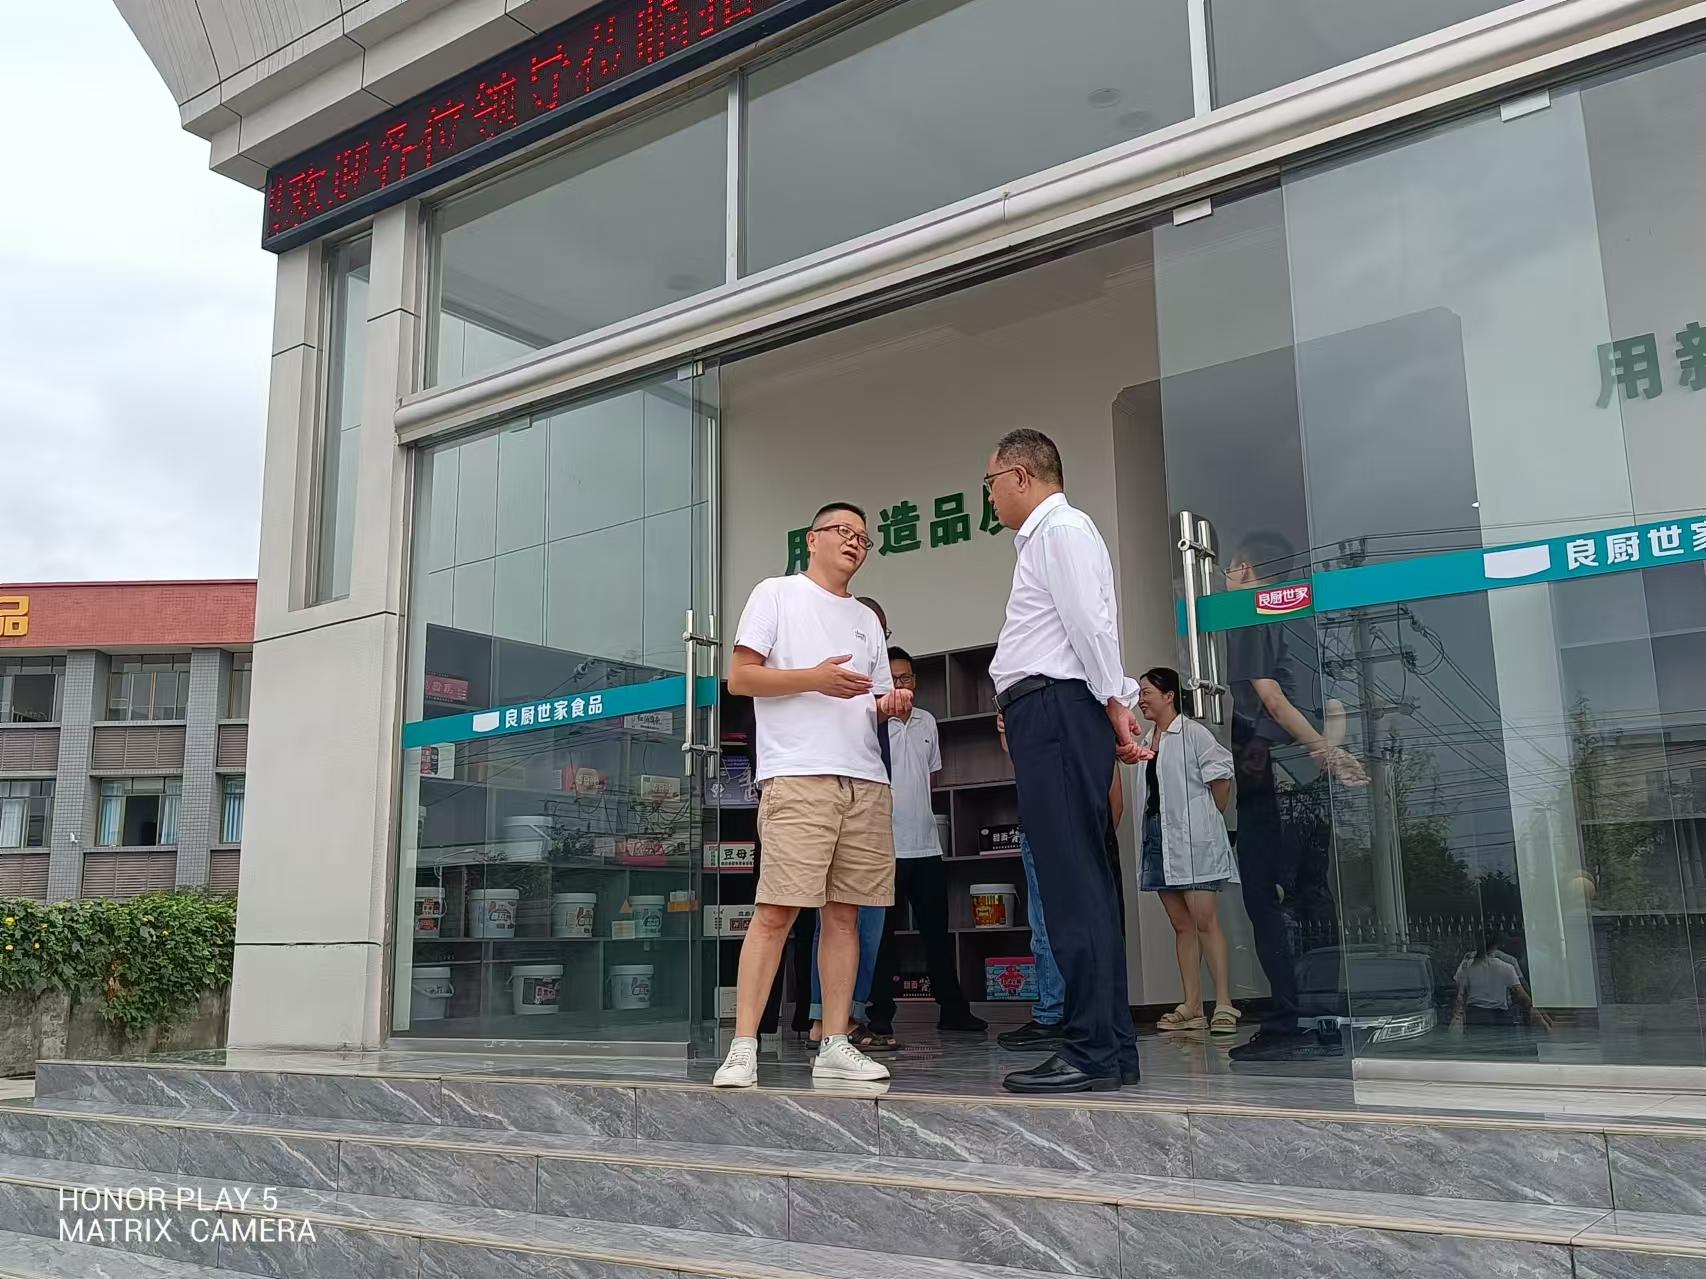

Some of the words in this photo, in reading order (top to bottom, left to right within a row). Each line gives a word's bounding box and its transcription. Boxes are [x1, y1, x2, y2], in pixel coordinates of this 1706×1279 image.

[1258, 586, 1309, 607] 良厨世家
[504, 694, 603, 729] 良厨世家食品
